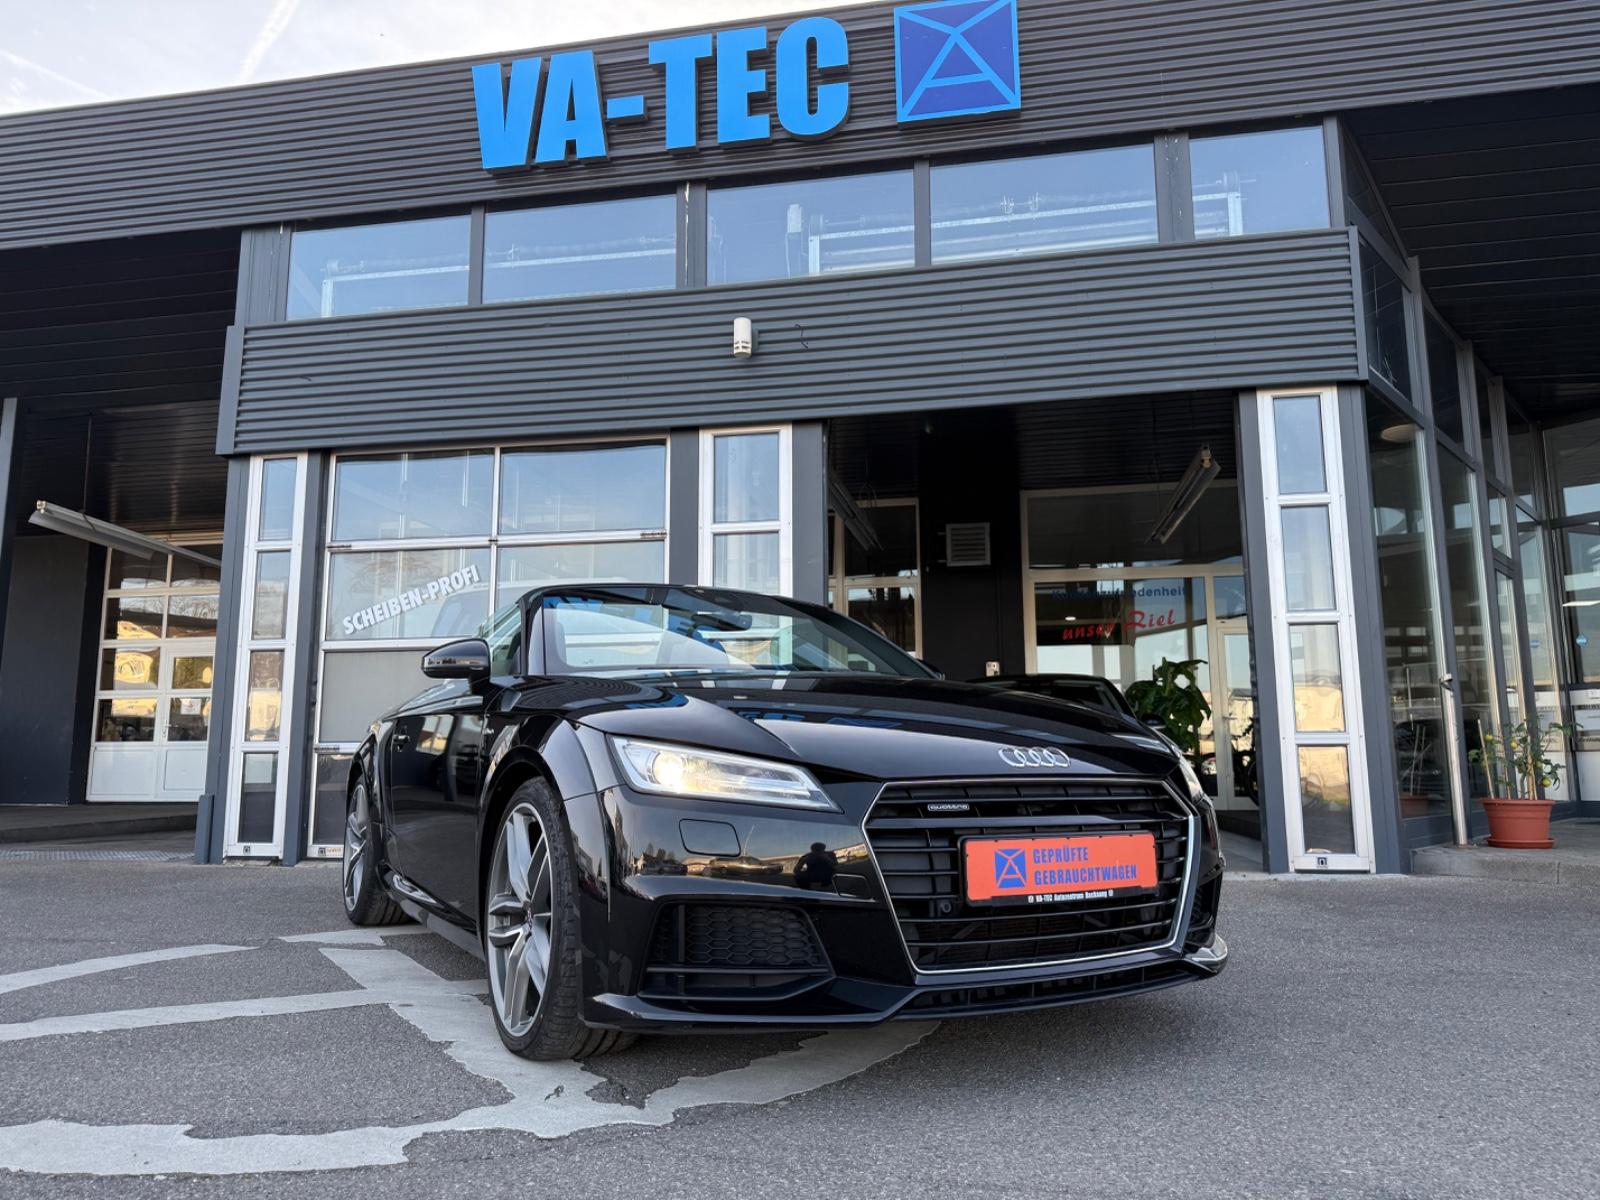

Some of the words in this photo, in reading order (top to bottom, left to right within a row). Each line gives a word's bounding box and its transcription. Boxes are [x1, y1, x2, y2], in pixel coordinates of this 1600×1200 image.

[472, 17, 849, 169] VA-TEC
[342, 564, 480, 635] SCHEIBEN-PROFI
[1033, 845, 1088, 864] GEPRÜFTE
[1034, 864, 1137, 885] GEBRAUCHTWAGEN
